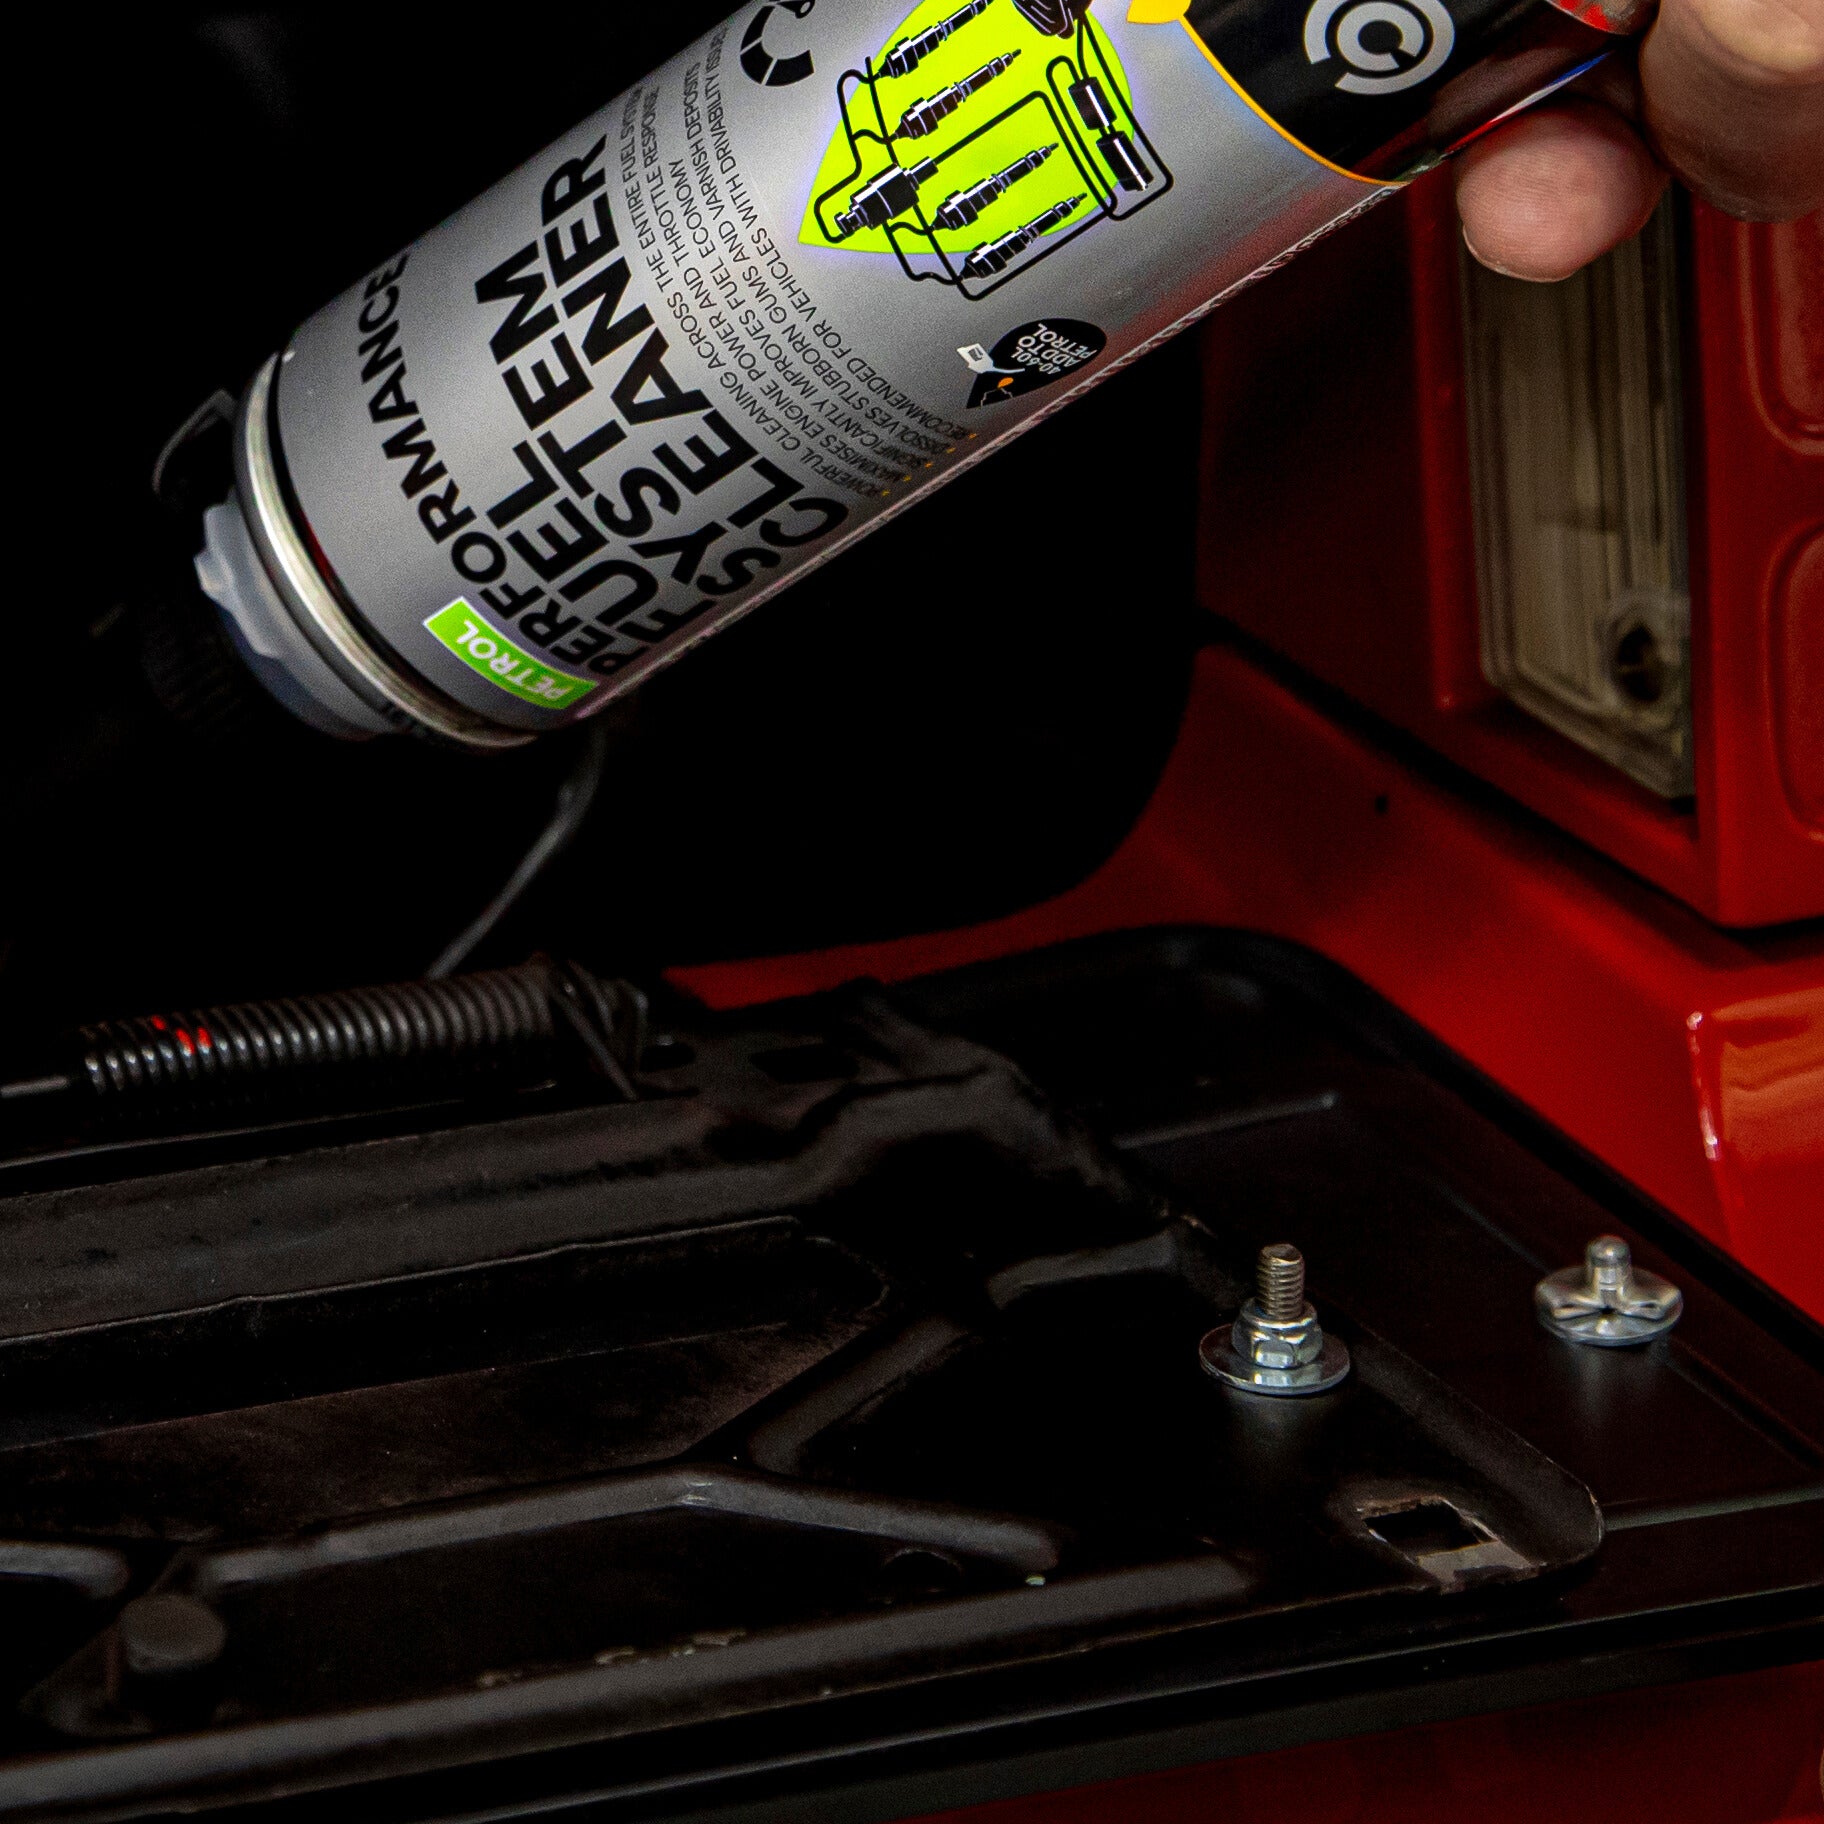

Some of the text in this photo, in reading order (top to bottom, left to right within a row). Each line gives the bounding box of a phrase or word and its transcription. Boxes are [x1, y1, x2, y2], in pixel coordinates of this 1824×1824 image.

[683, 62, 702, 140] DEPOSITS
[702, 72, 737, 174] DRIVABILITY
[620, 135, 637, 182] FUEL
[687, 137, 724, 220] VARNISH
[624, 180, 651, 249] ENTIRE
[644, 165, 690, 266] THROTTLE
[667, 157, 717, 258] ECONOMY
[725, 172, 756, 227] WITH
[645, 248, 674, 292] THE
[718, 222, 750, 260] AND
[750, 228, 816, 322] VEHICLES
[683, 268, 717, 308] AND
[708, 255, 746, 310] FUEL
[740, 264, 787, 323] GUMS
[536, 133, 848, 542] CLEANER
[667, 293, 726, 367] ACROSS
[708, 310, 766, 382] POWER
[738, 309, 819, 398] IMPROVES
[780, 323, 869, 410] STUBBORN
[813, 318, 851, 359] FOR
[1018, 336, 1081, 368] ADD TO
[1033, 323, 1097, 358] PETROL
[469, 239, 781, 596] SYSTEM
[718, 372, 800, 449] CLEANING
[760, 377, 824, 439] ENGINE
[361, 251, 642, 678] PERFORMANCE
[485, 439, 715, 650] FUEL
[458, 616, 574, 701] PETROL
